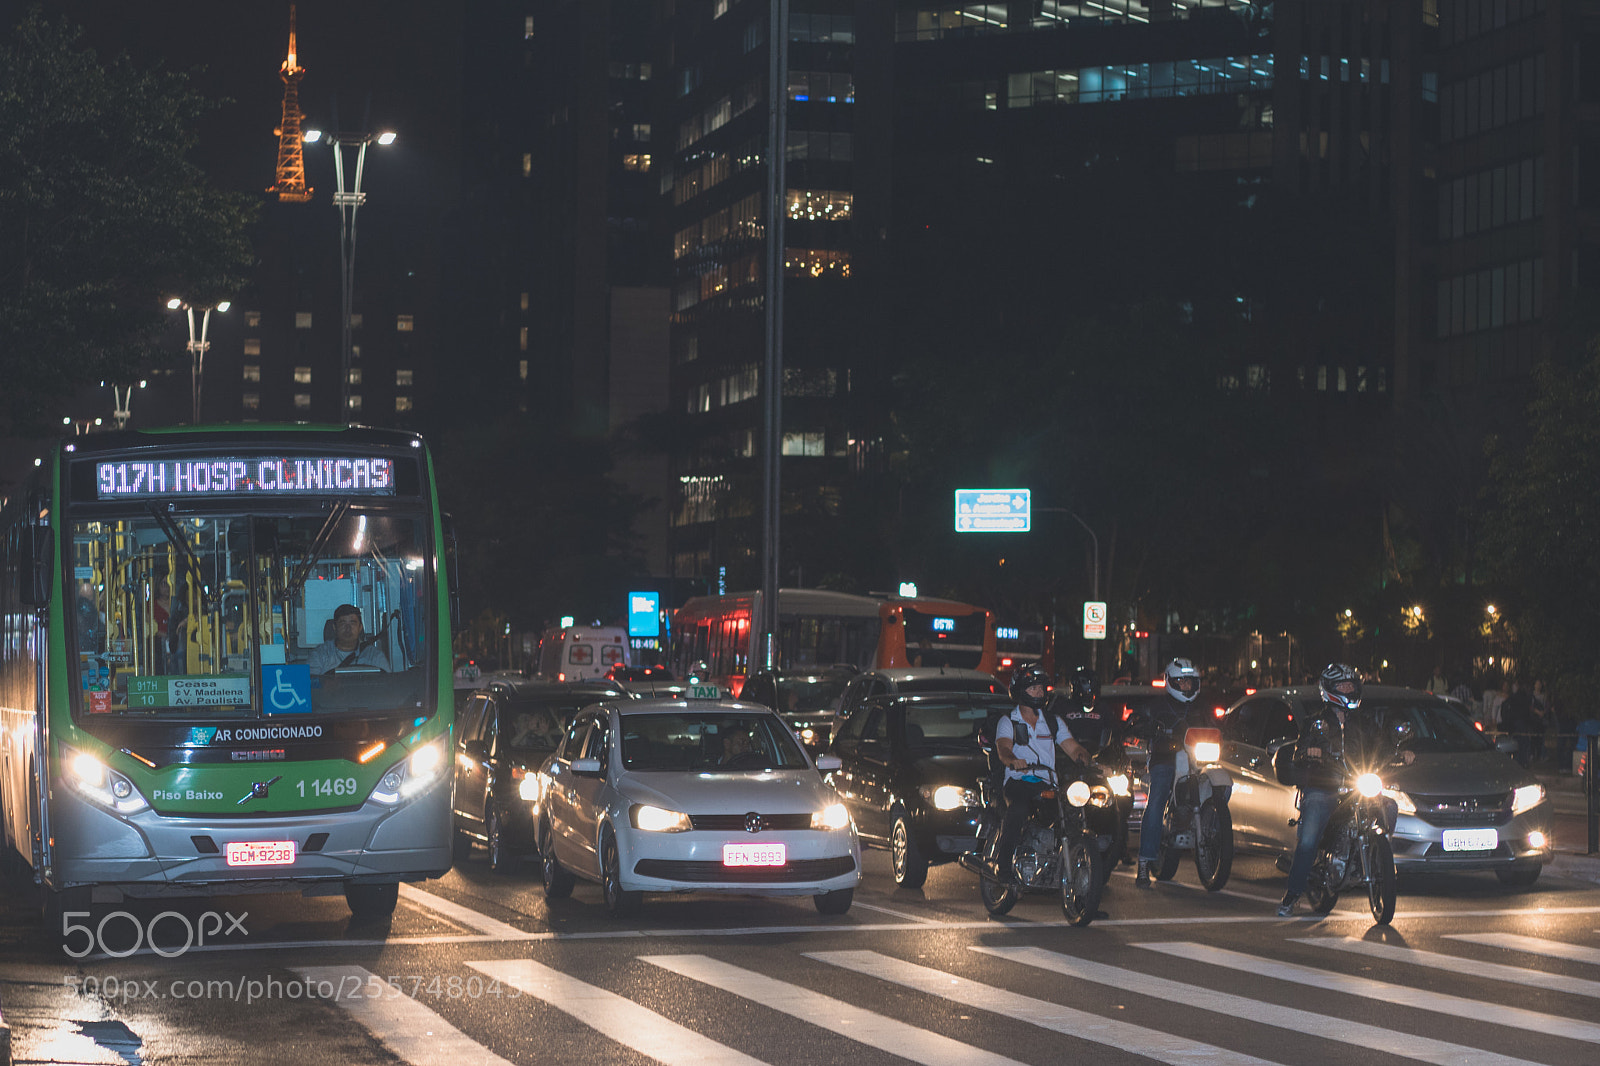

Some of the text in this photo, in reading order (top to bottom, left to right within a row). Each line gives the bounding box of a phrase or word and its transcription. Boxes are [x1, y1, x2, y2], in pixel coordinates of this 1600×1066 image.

[100, 463, 166, 493] 917H
[136, 681, 158, 691] 917H
[174, 680, 217, 688] Ceasa
[196, 689, 243, 697] Madalena
[691, 686, 718, 698] TAXI
[141, 695, 155, 705] 10
[197, 697, 244, 705] Paulista
[215, 725, 323, 742] AR CONDICIONADO
[153, 790, 224, 800] Piso Baixo
